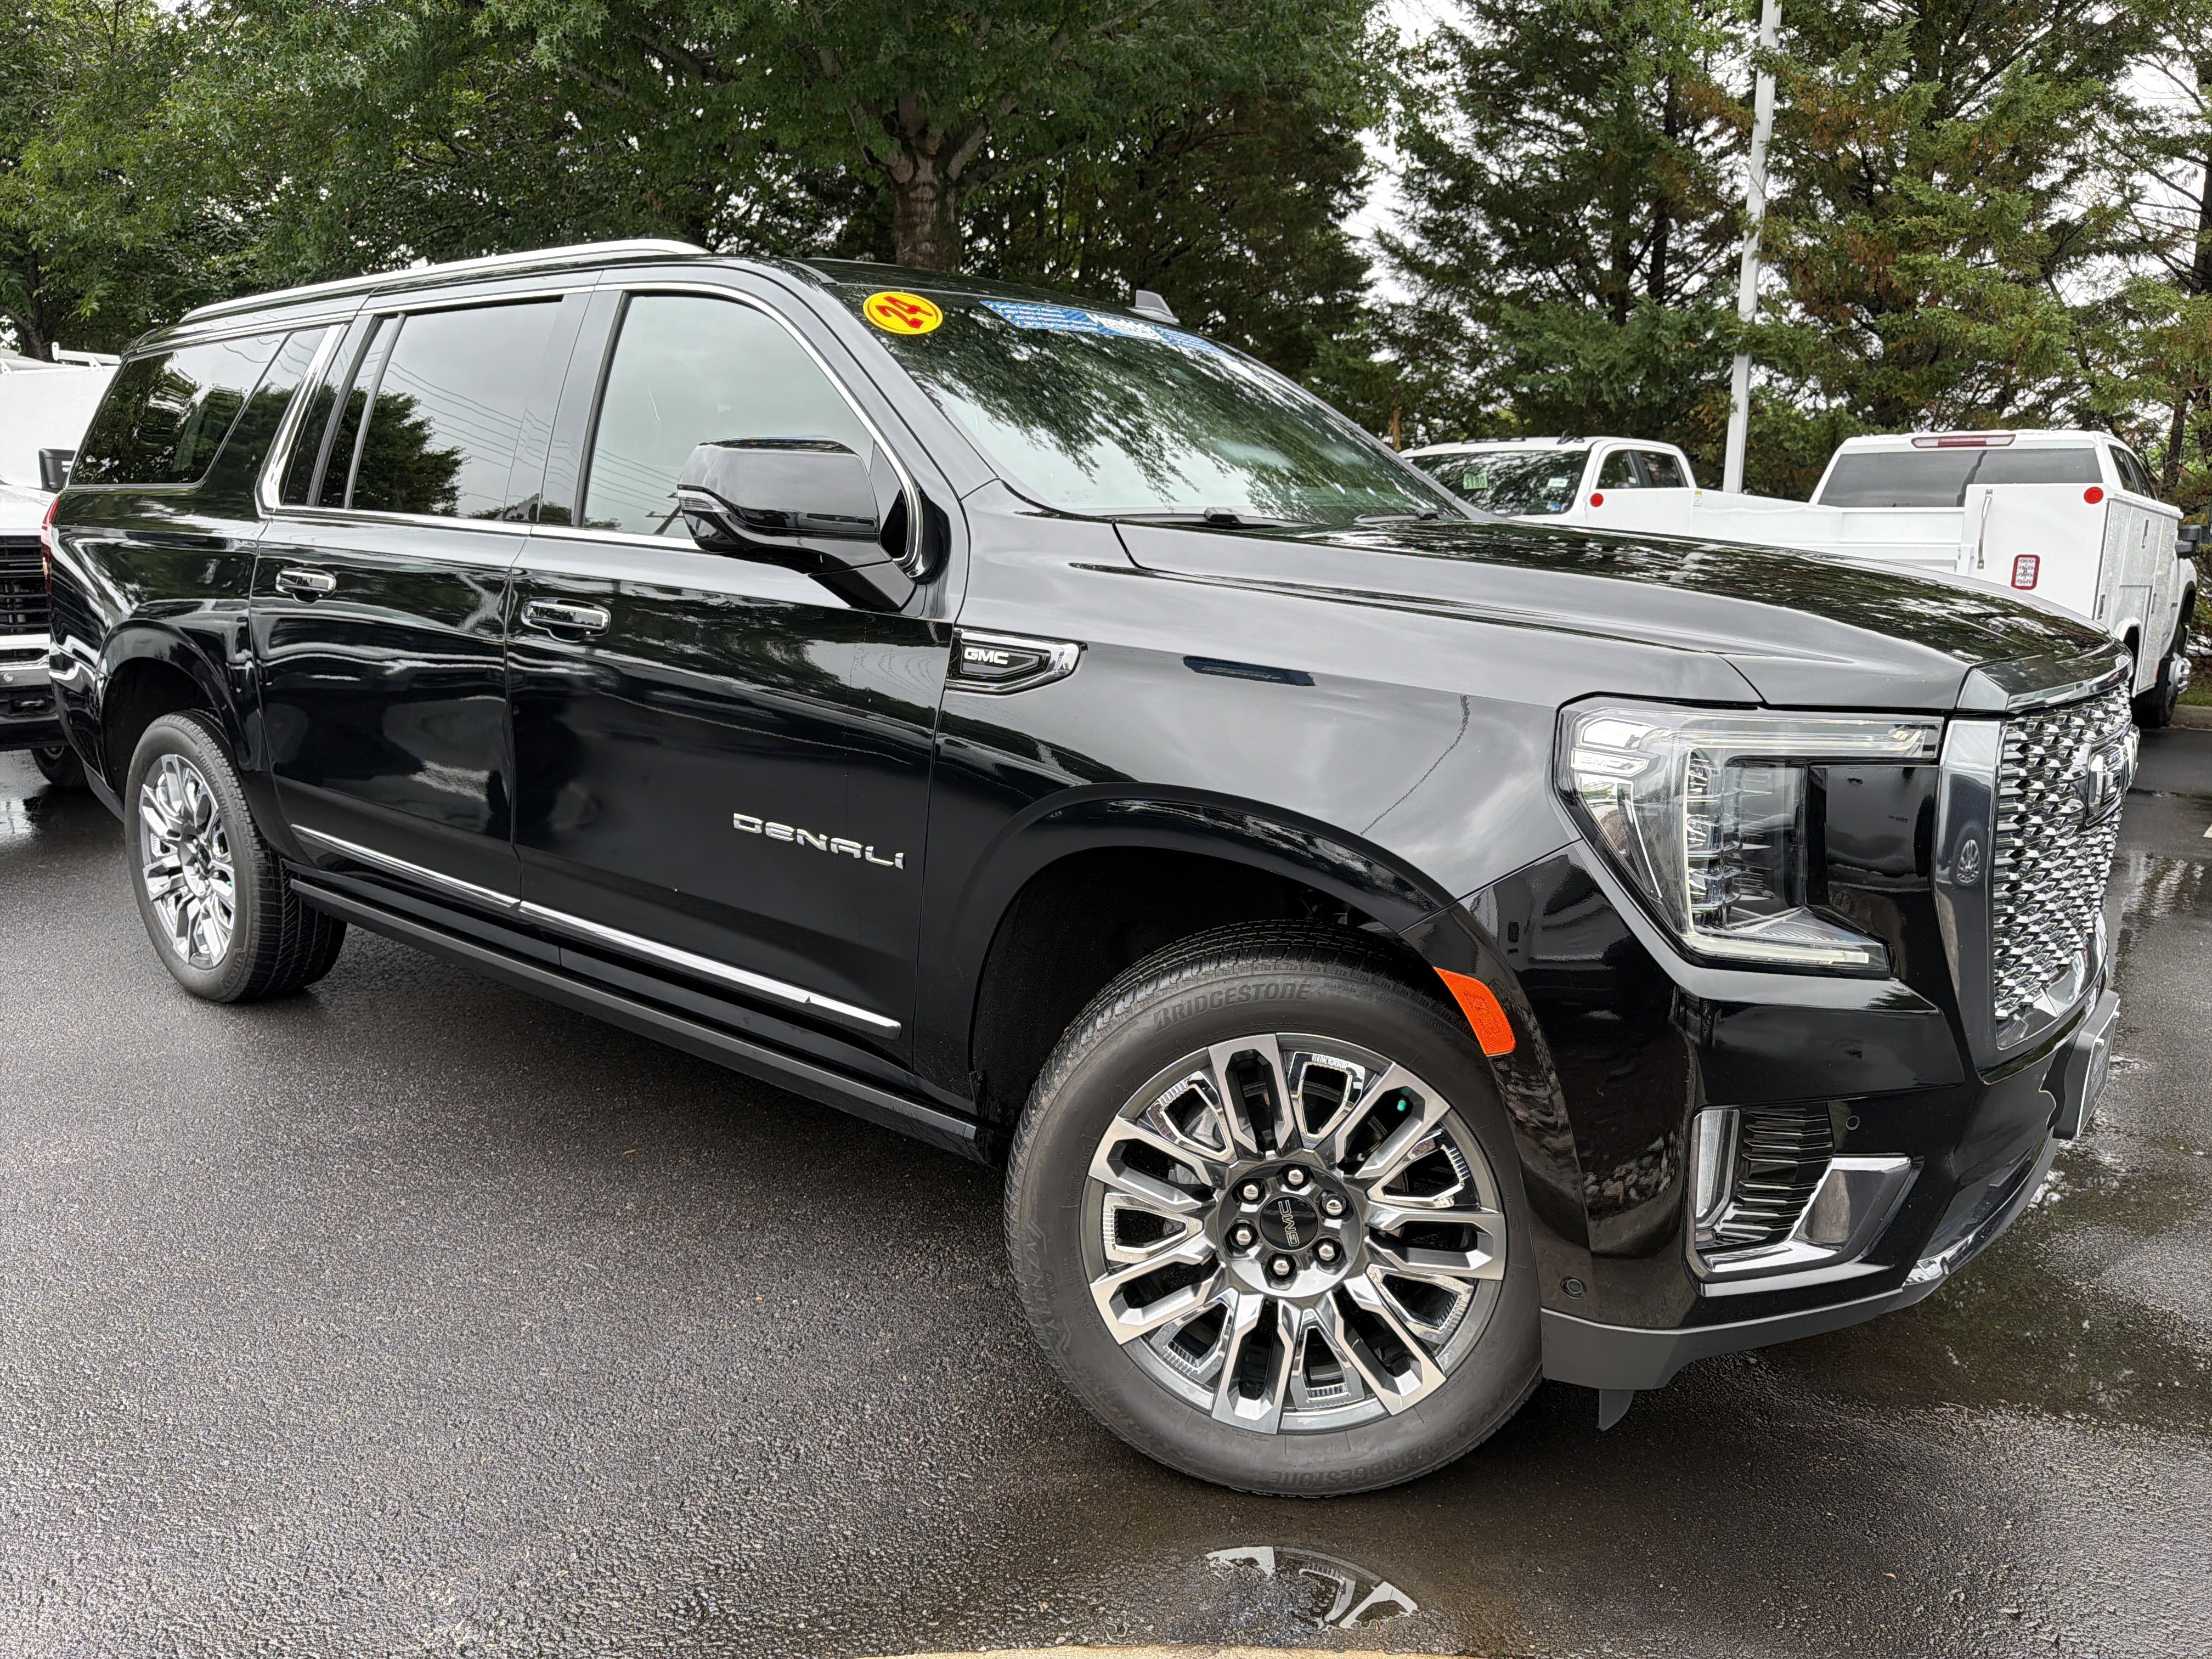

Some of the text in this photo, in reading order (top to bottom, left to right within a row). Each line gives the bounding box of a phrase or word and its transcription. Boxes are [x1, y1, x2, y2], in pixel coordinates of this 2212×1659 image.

[875, 296, 934, 329] 24
[963, 647, 1009, 665] GMC
[733, 812, 906, 870] DENALI
[1153, 979, 1311, 1034] BRIDGESTONE
[1278, 1199, 1301, 1248] GMC
[1025, 1241, 1059, 1331] ALENZA
